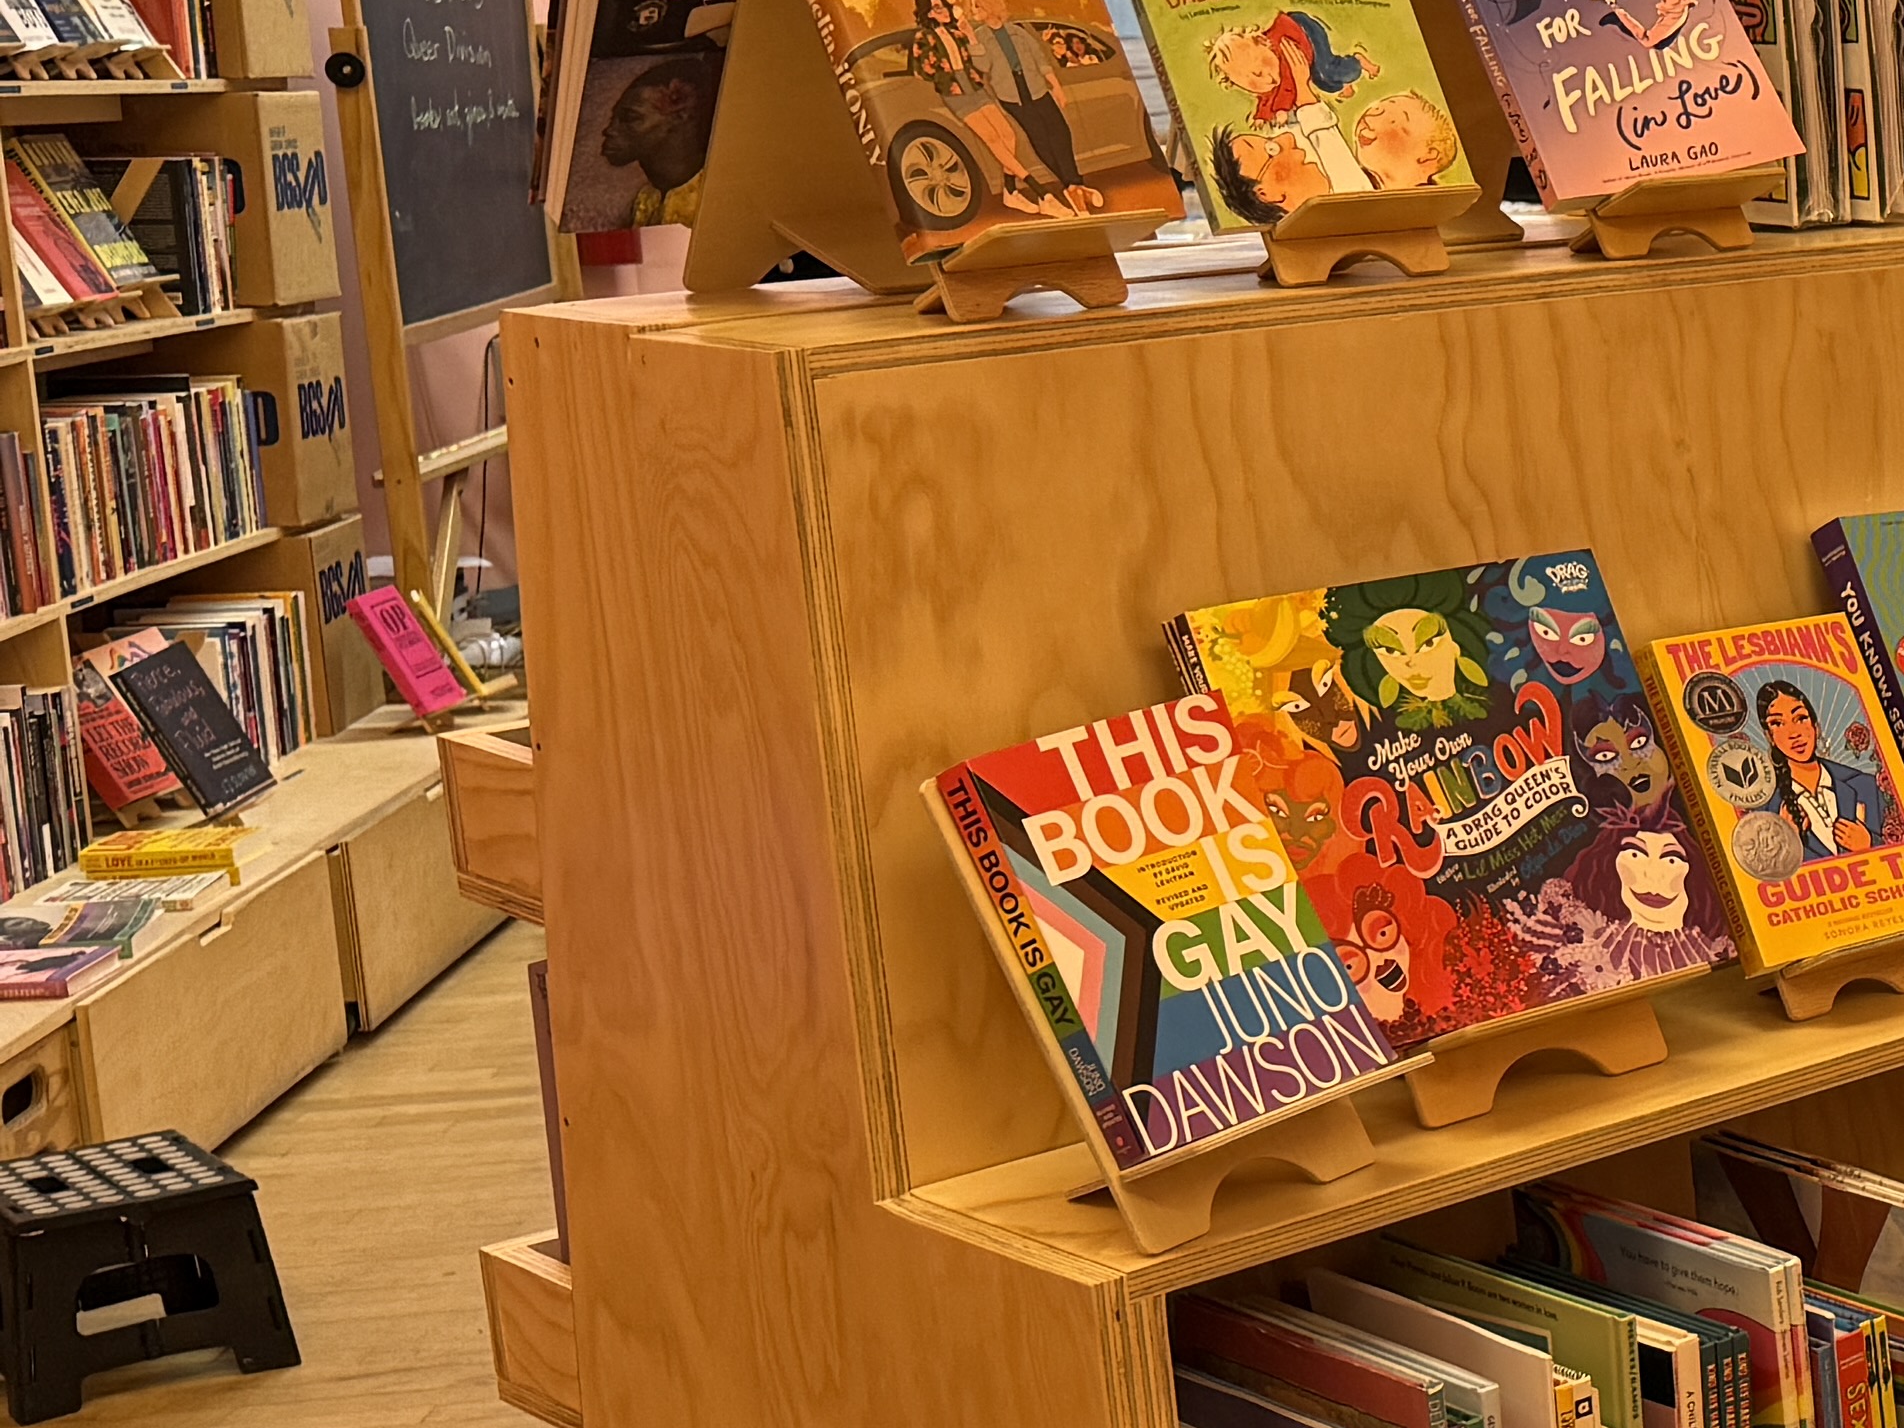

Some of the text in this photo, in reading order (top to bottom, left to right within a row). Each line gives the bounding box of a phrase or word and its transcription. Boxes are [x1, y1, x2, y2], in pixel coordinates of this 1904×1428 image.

[1536, 8, 1591, 48] FOR
[1552, 22, 1724, 134] FALLING
[1629, 141, 1719, 171] LAURA GAO
[1666, 640, 1723, 678] THE
[1036, 694, 1233, 802] THIS
[1339, 681, 1562, 879] RAINBOW
[1368, 731, 1422, 770] Make
[1389, 732, 1473, 791] Your Own
[1022, 754, 1267, 886] BOOK
[1447, 767, 1566, 840] A DRAG QUEEN'S
[1455, 782, 1572, 851] GUIDE TO COLOR
[1200, 822, 1289, 902] IS
[1757, 857, 1878, 909] GUIDE
[1152, 882, 1313, 991] GAY
[1767, 892, 1860, 928] CATHOLIC
[1200, 945, 1349, 1055] JUNO
[1121, 1004, 1389, 1156] DAWSON
